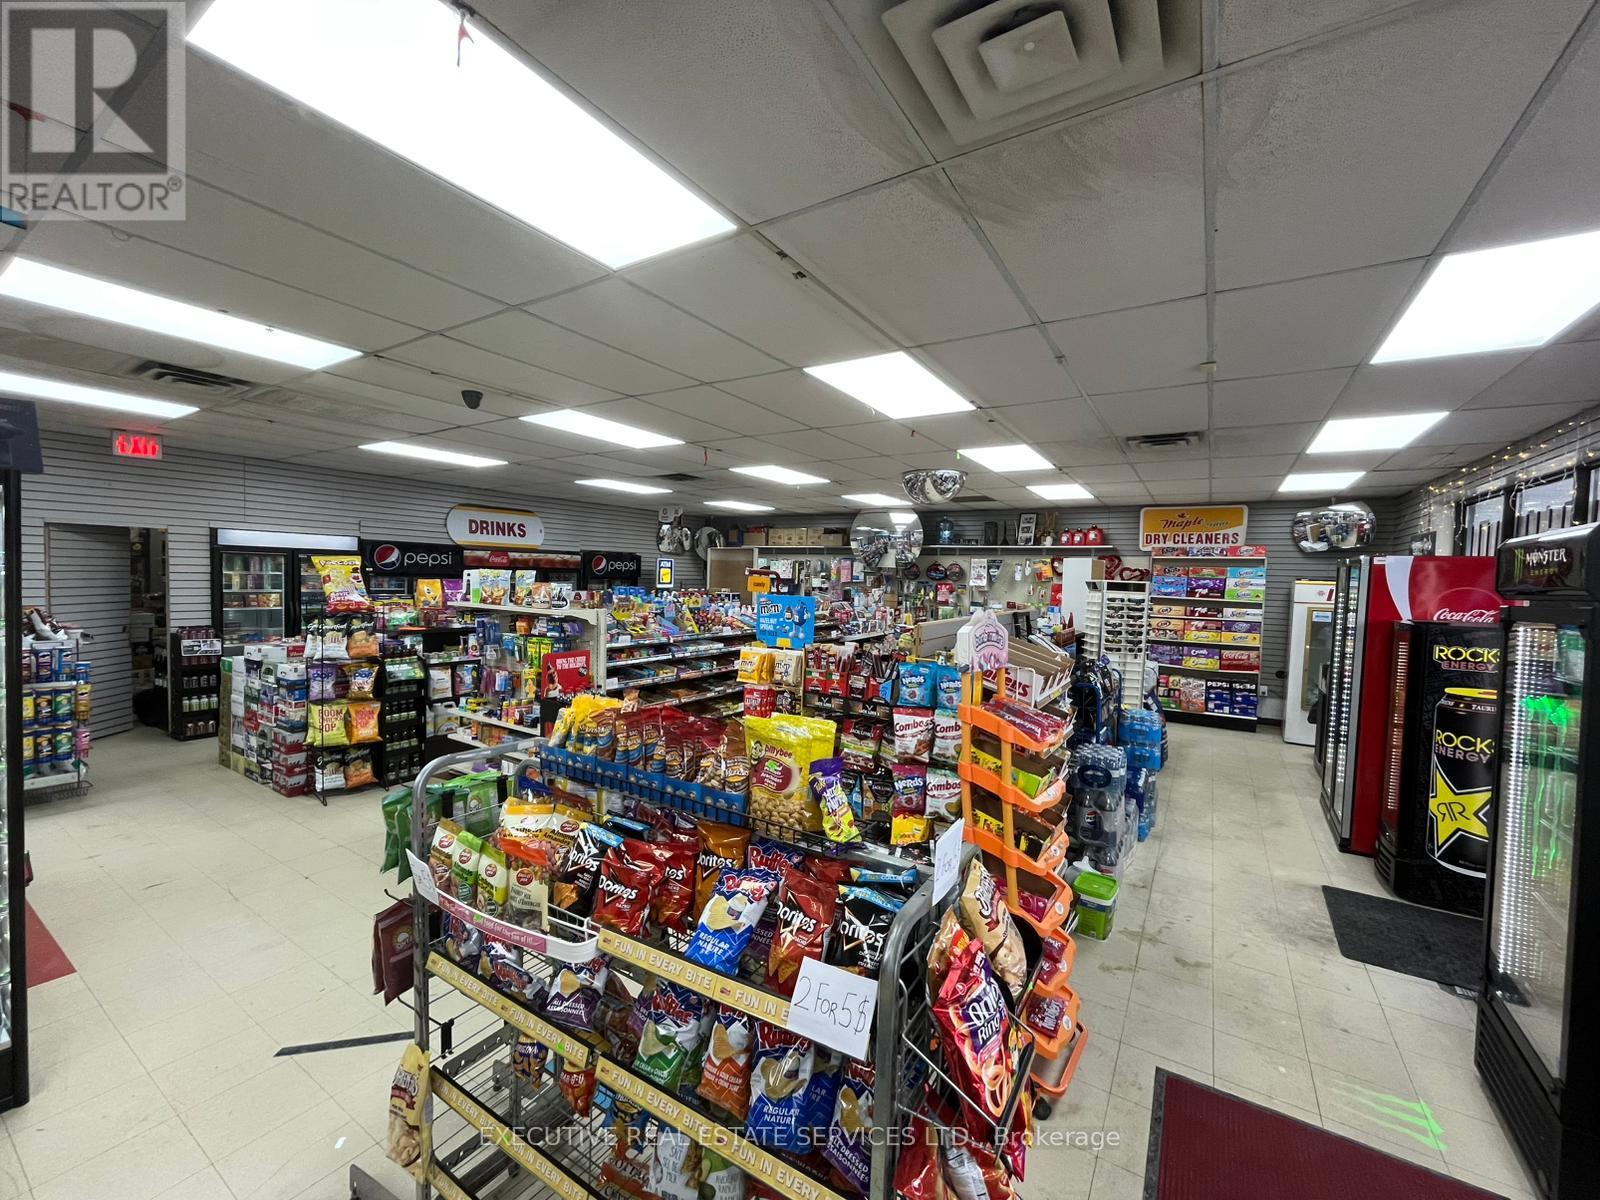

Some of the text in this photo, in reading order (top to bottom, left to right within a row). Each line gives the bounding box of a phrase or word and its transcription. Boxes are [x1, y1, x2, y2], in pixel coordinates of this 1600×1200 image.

[468, 518, 527, 538] DRINKS
[1145, 532, 1240, 545] DRY CLEANERS
[404, 552, 452, 567] pepsi
[608, 560, 637, 573] pepsi
[660, 560, 671, 568] ATM
[1434, 644, 1500, 664] ROCK
[1442, 660, 1494, 672] ENERGY
[935, 723, 961, 733] Comb
[926, 780, 961, 792] Combos
[571, 850, 601, 872] oritos
[599, 874, 639, 900] Doritos
[699, 931, 730, 951] REGULAR
[840, 920, 884, 947] oritos
[697, 939, 724, 955] NATURE
[614, 940, 712, 990] FUN IN EVERY BITE
[438, 961, 450, 978] FUN
[450, 970, 458, 982] IN
[459, 975, 481, 996] EVERY
[481, 990, 498, 1006] BITE
[794, 976, 812, 1011] 2
[562, 1000, 585, 1009] DESSED
[735, 988, 760, 1010] FUN
[763, 1001, 778, 1017] IN
[510, 1008, 584, 1060] FUN IN EVERY BITE
[457, 1101, 478, 1119] EVERY
[613, 1071, 632, 1091] FUN
[633, 1083, 645, 1097] IN
[647, 1092, 681, 1120] EVERY
[683, 1114, 708, 1134] BITE
[763, 1104, 800, 1117] REGULAR
[764, 1115, 796, 1126] NATURE
[839, 1142, 869, 1174] DRESSED
[526, 1154, 535, 1166] IN
[536, 1161, 562, 1183] EVERY
[563, 1180, 584, 1199] BITE
[731, 1143, 821, 1200] FUN IN EVERY
